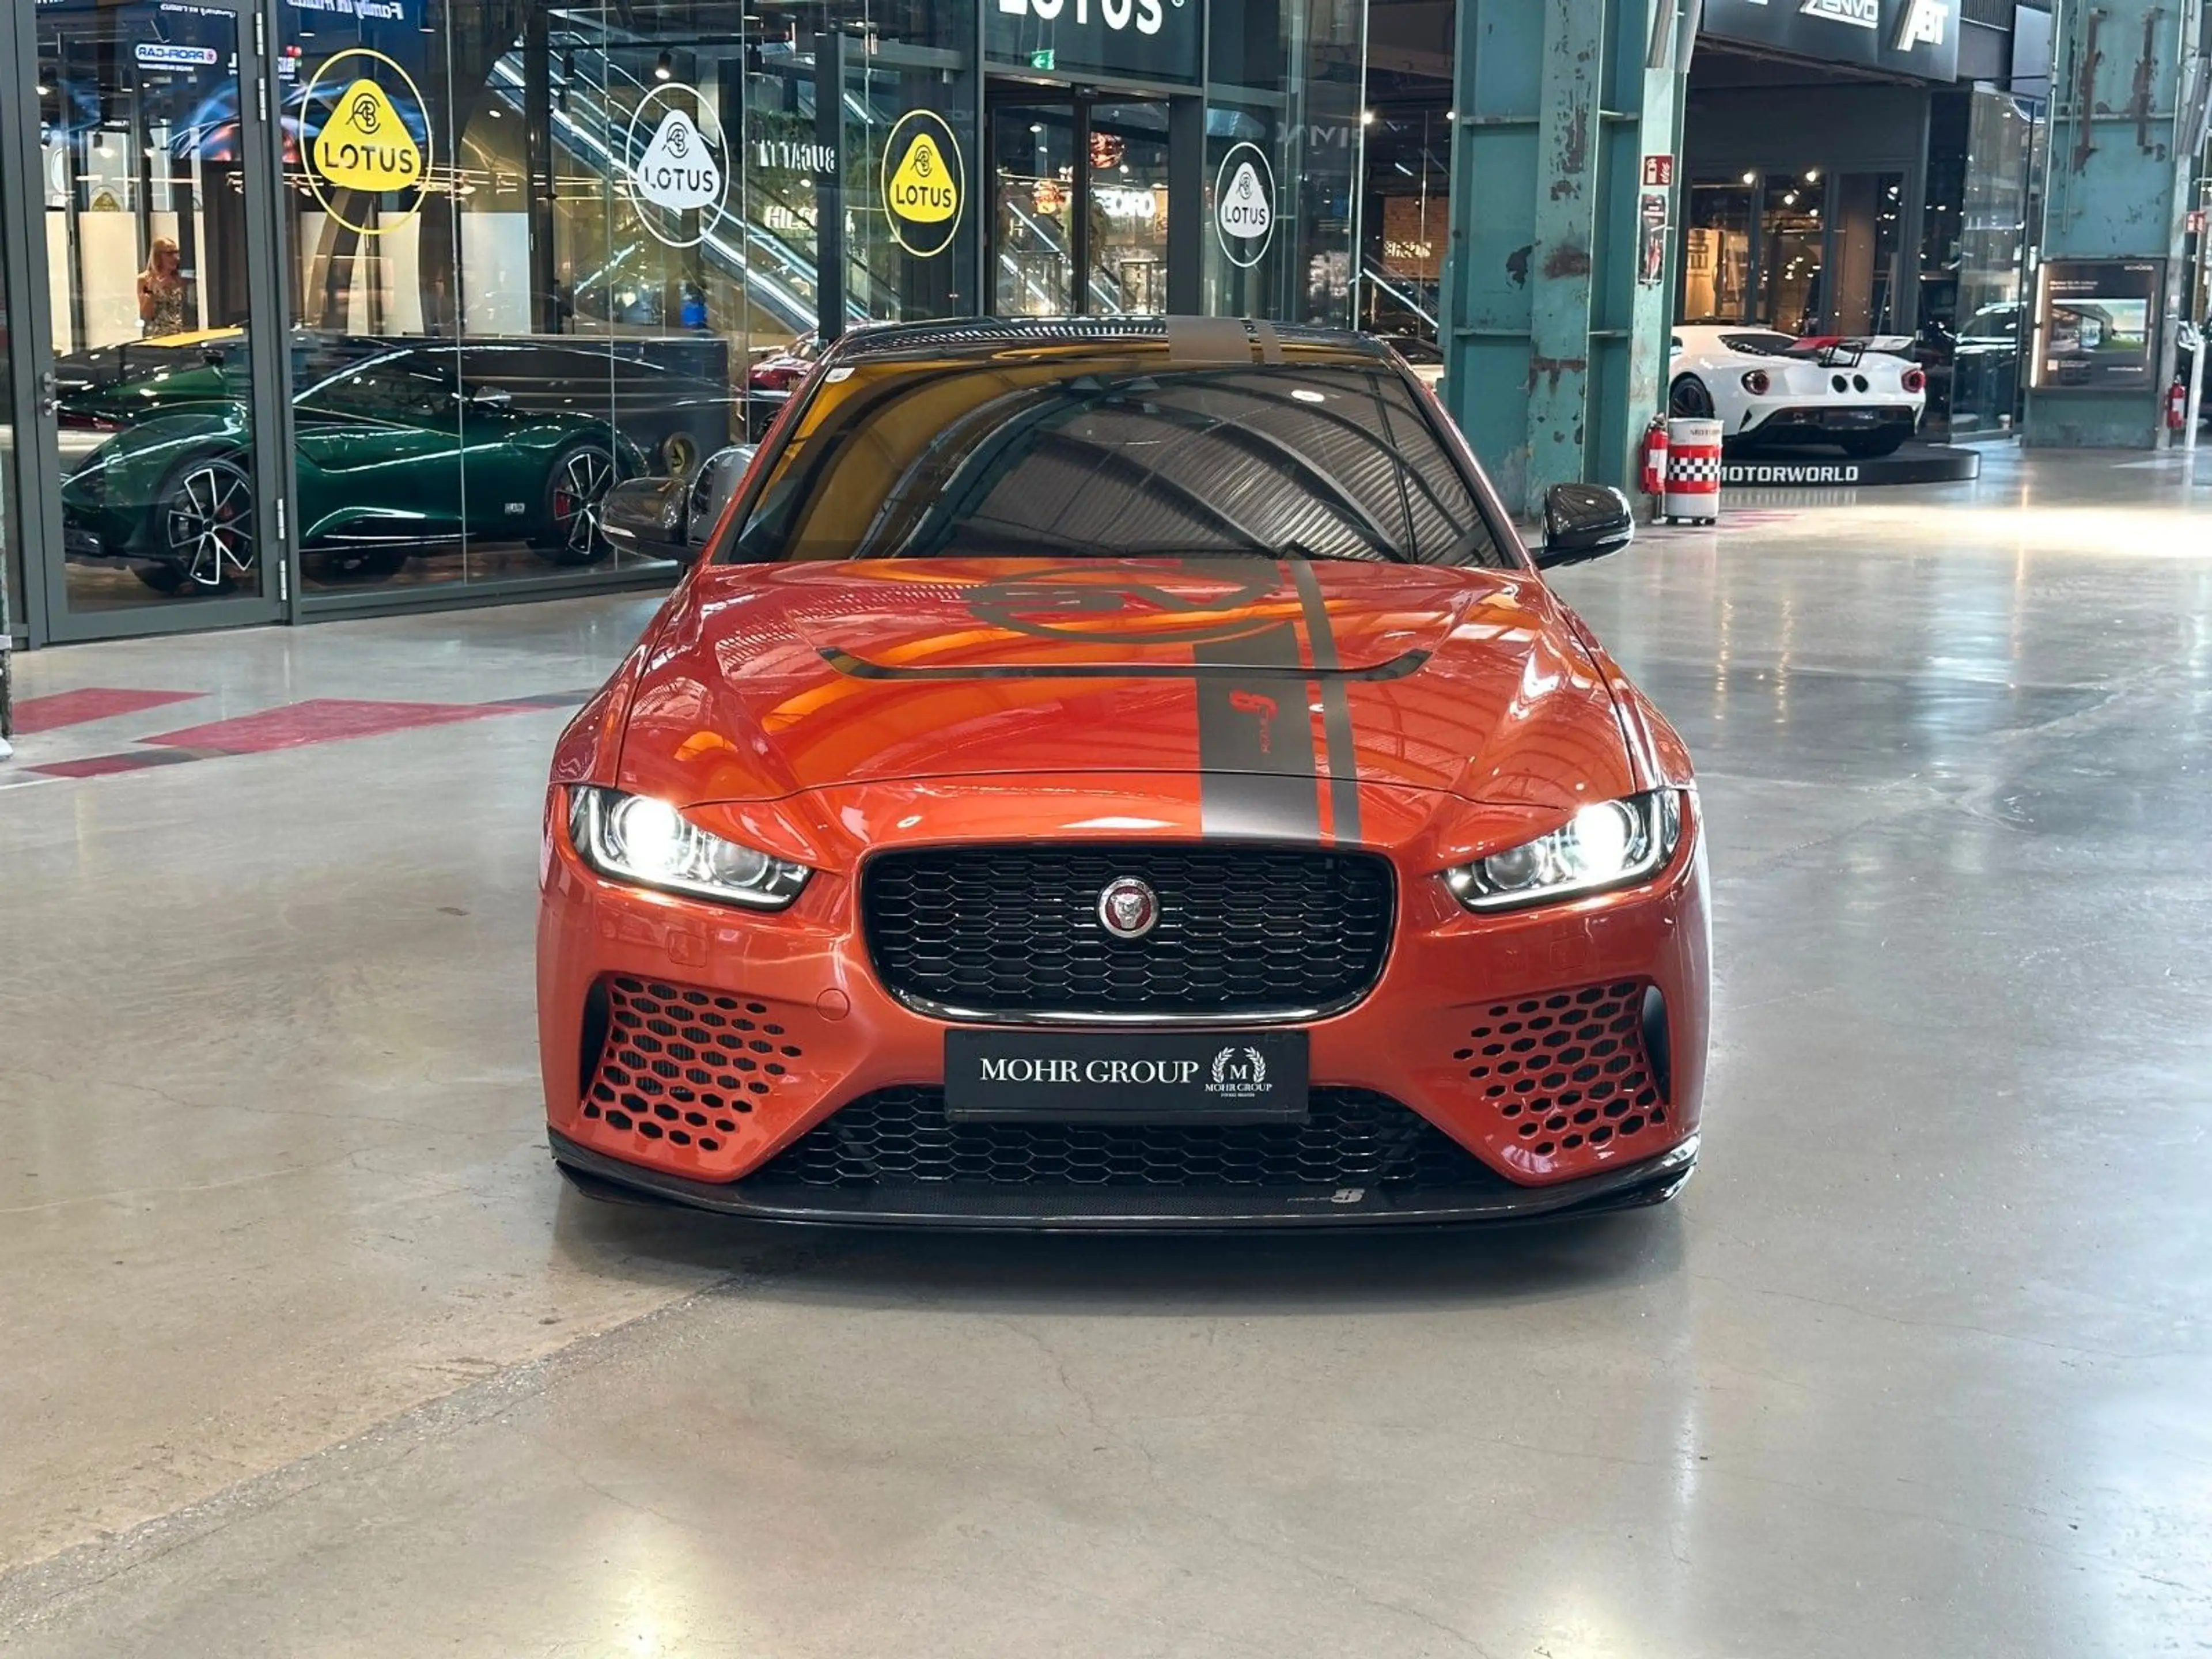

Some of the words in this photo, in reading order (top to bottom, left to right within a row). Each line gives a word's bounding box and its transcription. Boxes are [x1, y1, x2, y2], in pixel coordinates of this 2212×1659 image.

[1896, 0, 1949, 52] ABT
[324, 142, 414, 174] LOTUS
[644, 166, 714, 192] LOTUS
[896, 183, 952, 209] LOTUS
[1224, 205, 1267, 225] LOTUS
[979, 1058, 1081, 1082] MOHR
[1085, 1059, 1199, 1084] GROUP
[1229, 1065, 1247, 1080] M
[1205, 1083, 1236, 1092] MOHR
[1236, 1083, 1273, 1092] GROUP
